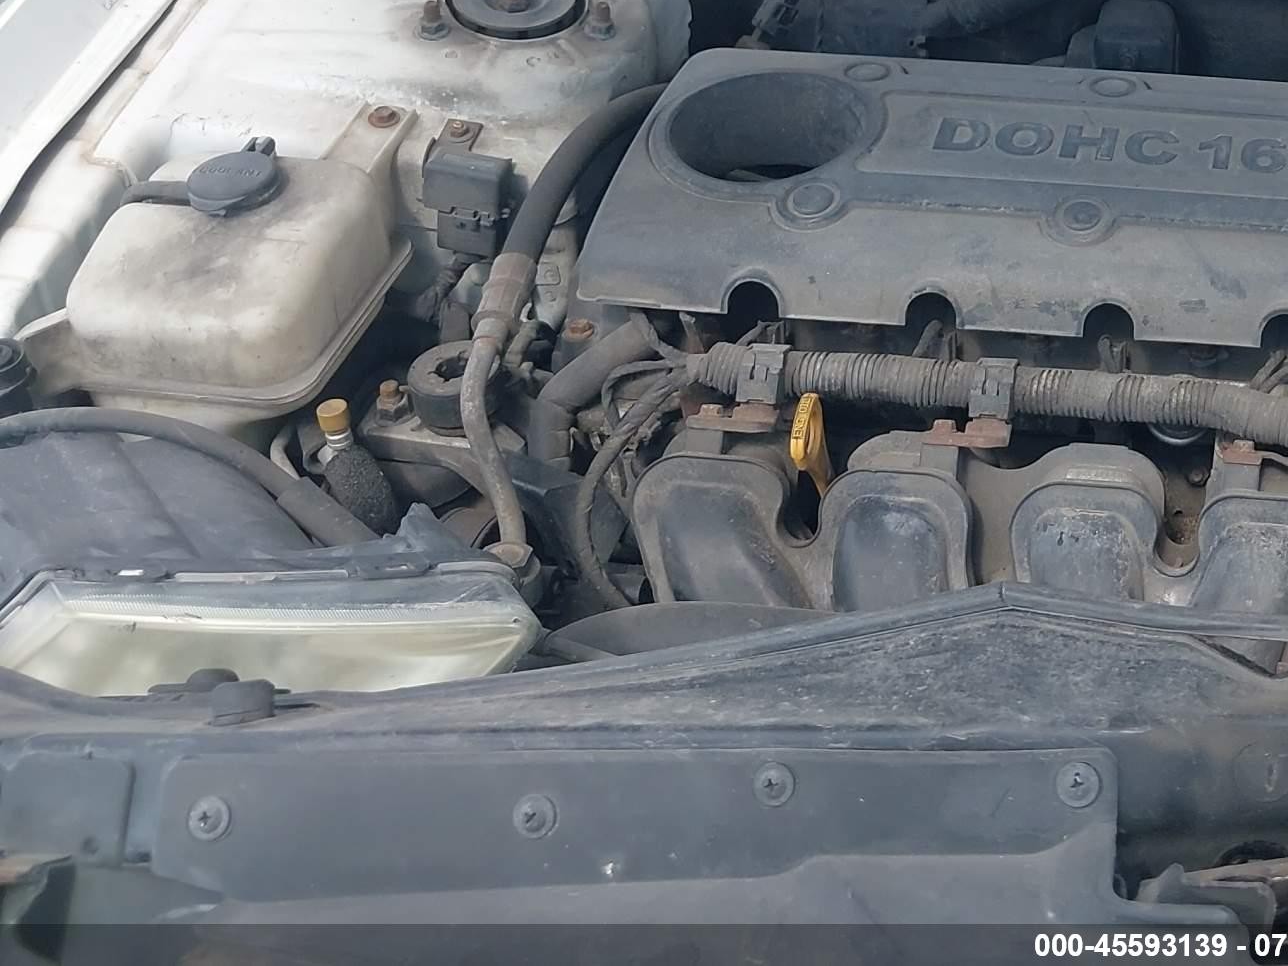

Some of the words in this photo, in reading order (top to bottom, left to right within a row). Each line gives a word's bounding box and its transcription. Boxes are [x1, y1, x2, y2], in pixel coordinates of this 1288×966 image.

[932, 115, 1180, 168] DOHC
[199, 165, 262, 177] COOLANT
[793, 418, 804, 437] ENG
[799, 396, 811, 413] OIL
